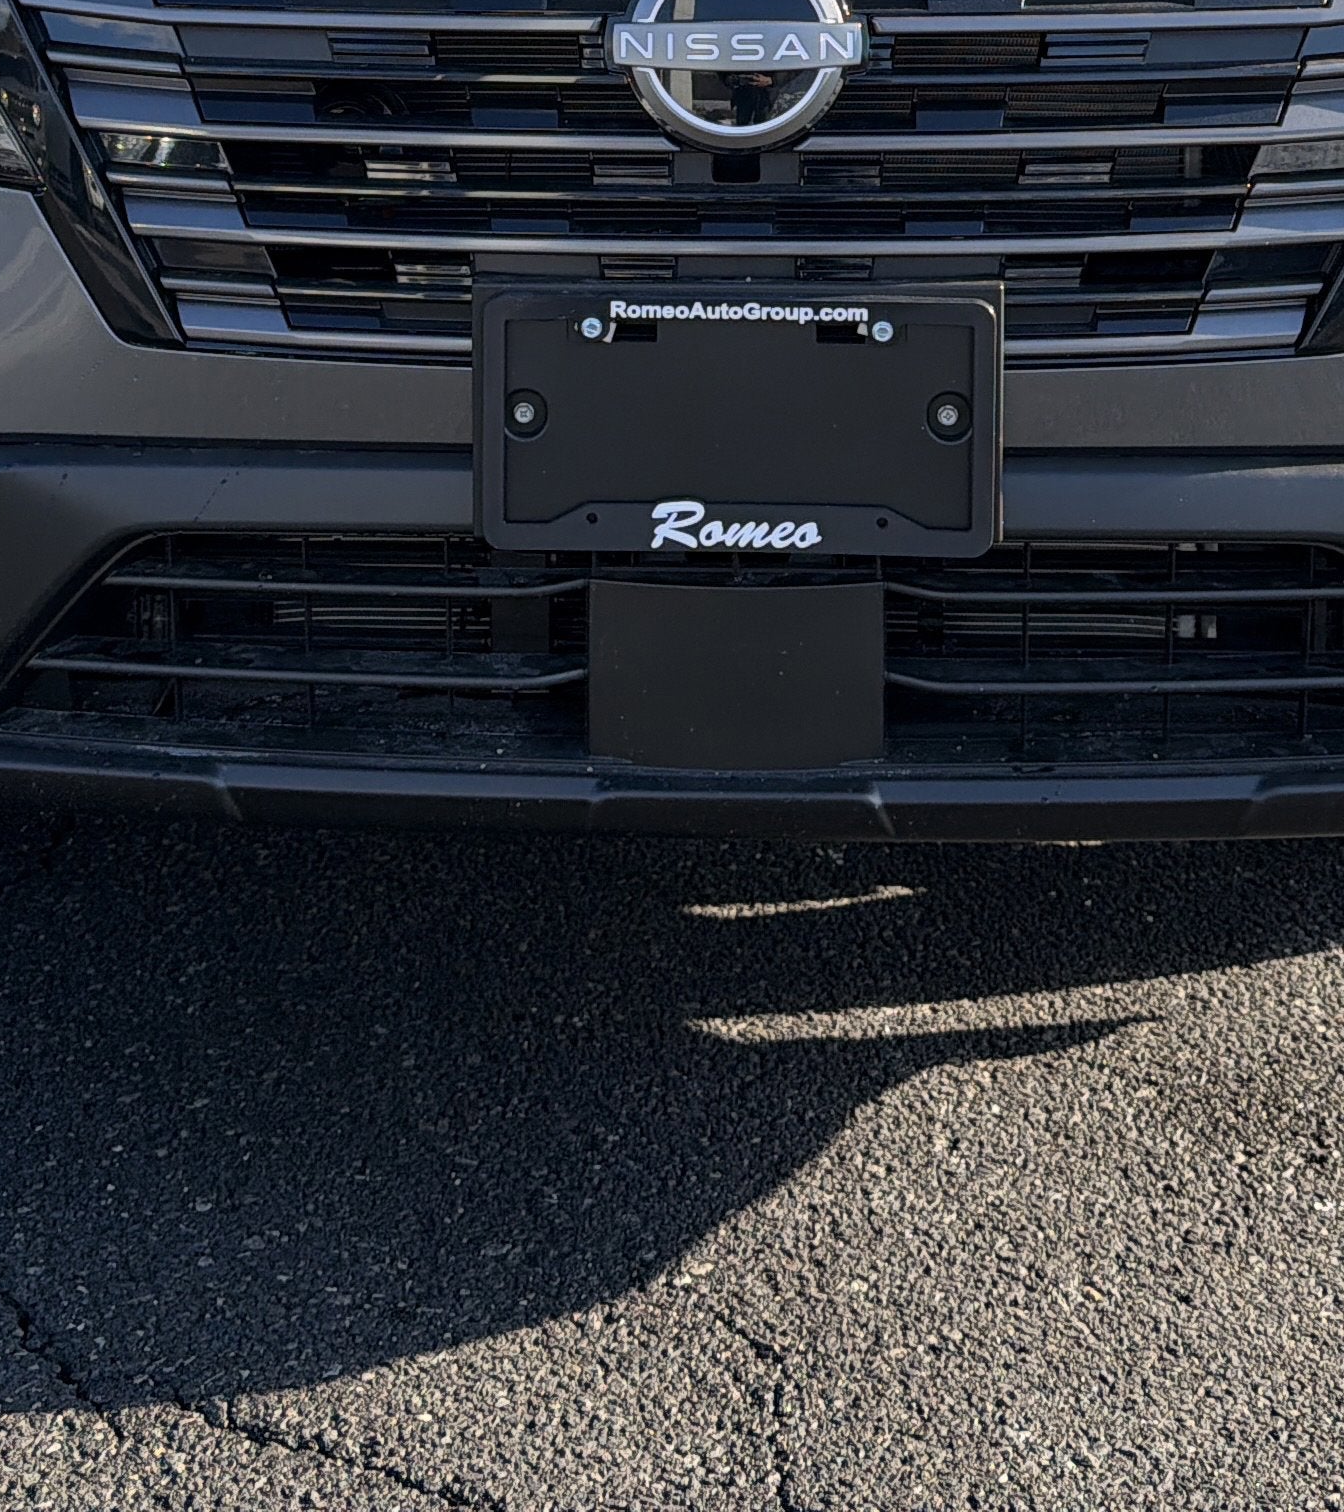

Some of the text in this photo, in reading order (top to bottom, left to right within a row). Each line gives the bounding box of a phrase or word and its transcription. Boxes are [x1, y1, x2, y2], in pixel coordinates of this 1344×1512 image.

[620, 30, 854, 61] NISSAN
[609, 300, 869, 325] RomeoAutoGroup.com
[650, 500, 822, 550] Romeo
